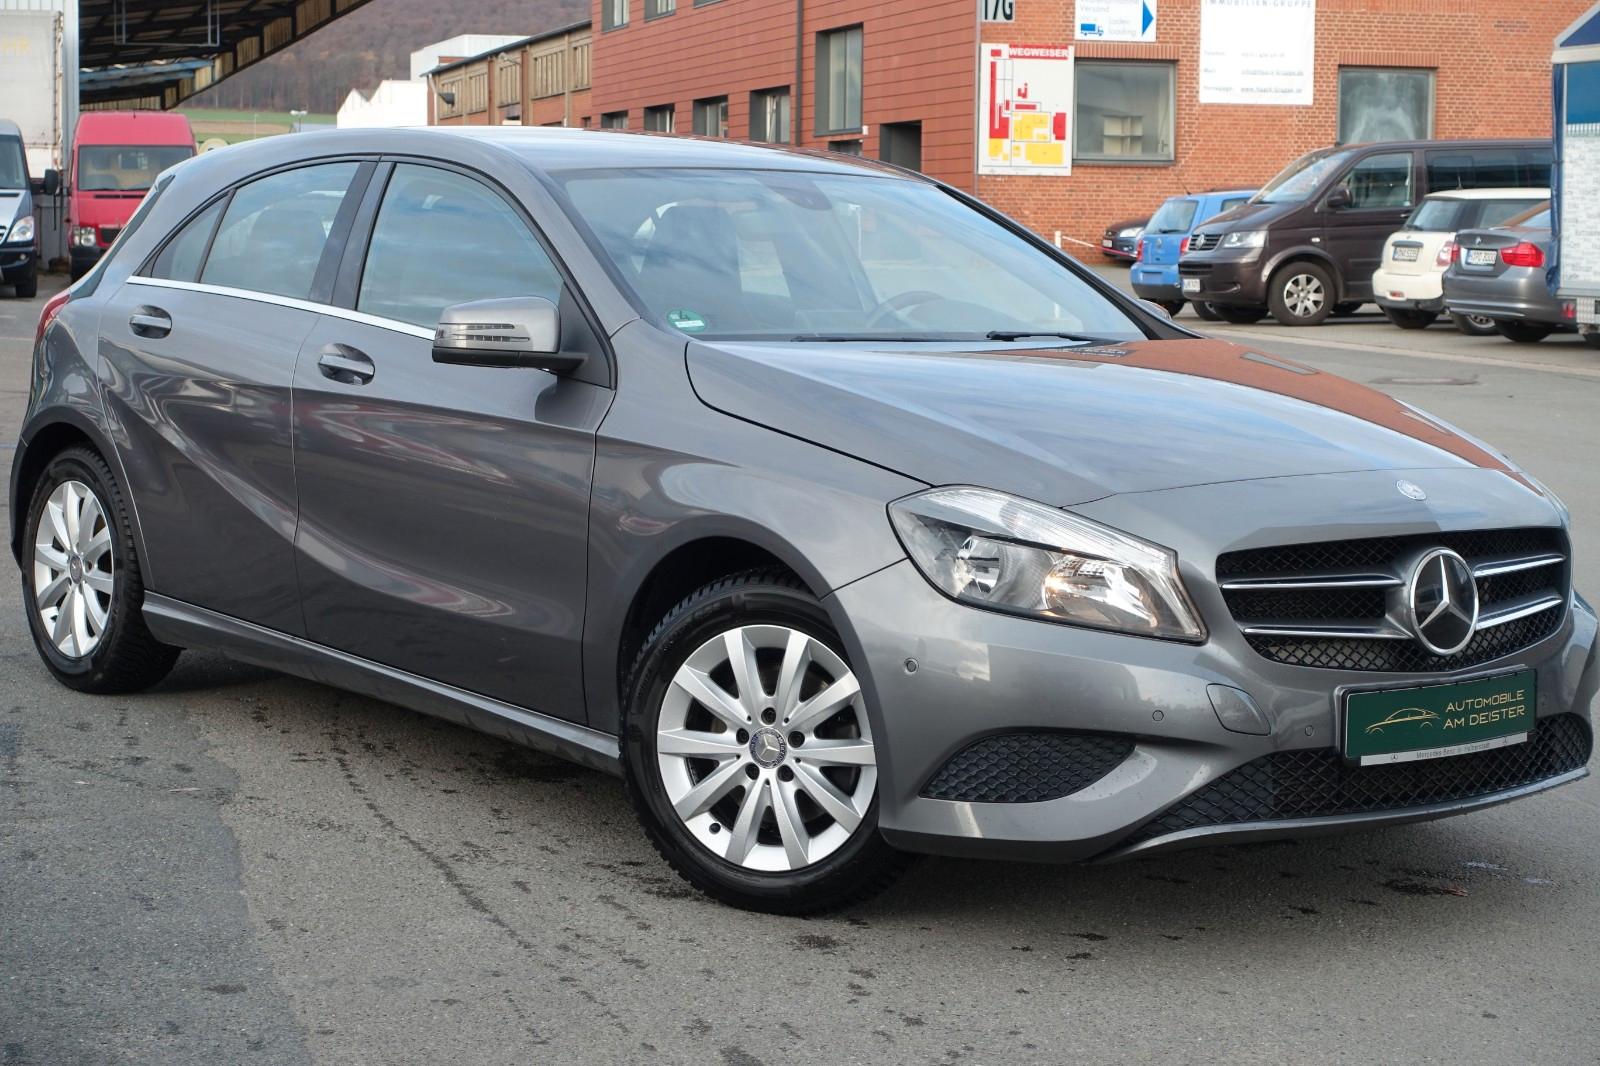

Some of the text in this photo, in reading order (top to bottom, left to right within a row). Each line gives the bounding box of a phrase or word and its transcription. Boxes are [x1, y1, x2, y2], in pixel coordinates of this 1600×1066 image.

[1009, 48, 1069, 58] WEGWEISER
[1445, 689, 1525, 712] AUTOMOBILE
[1443, 705, 1525, 730] AM DEISTER
